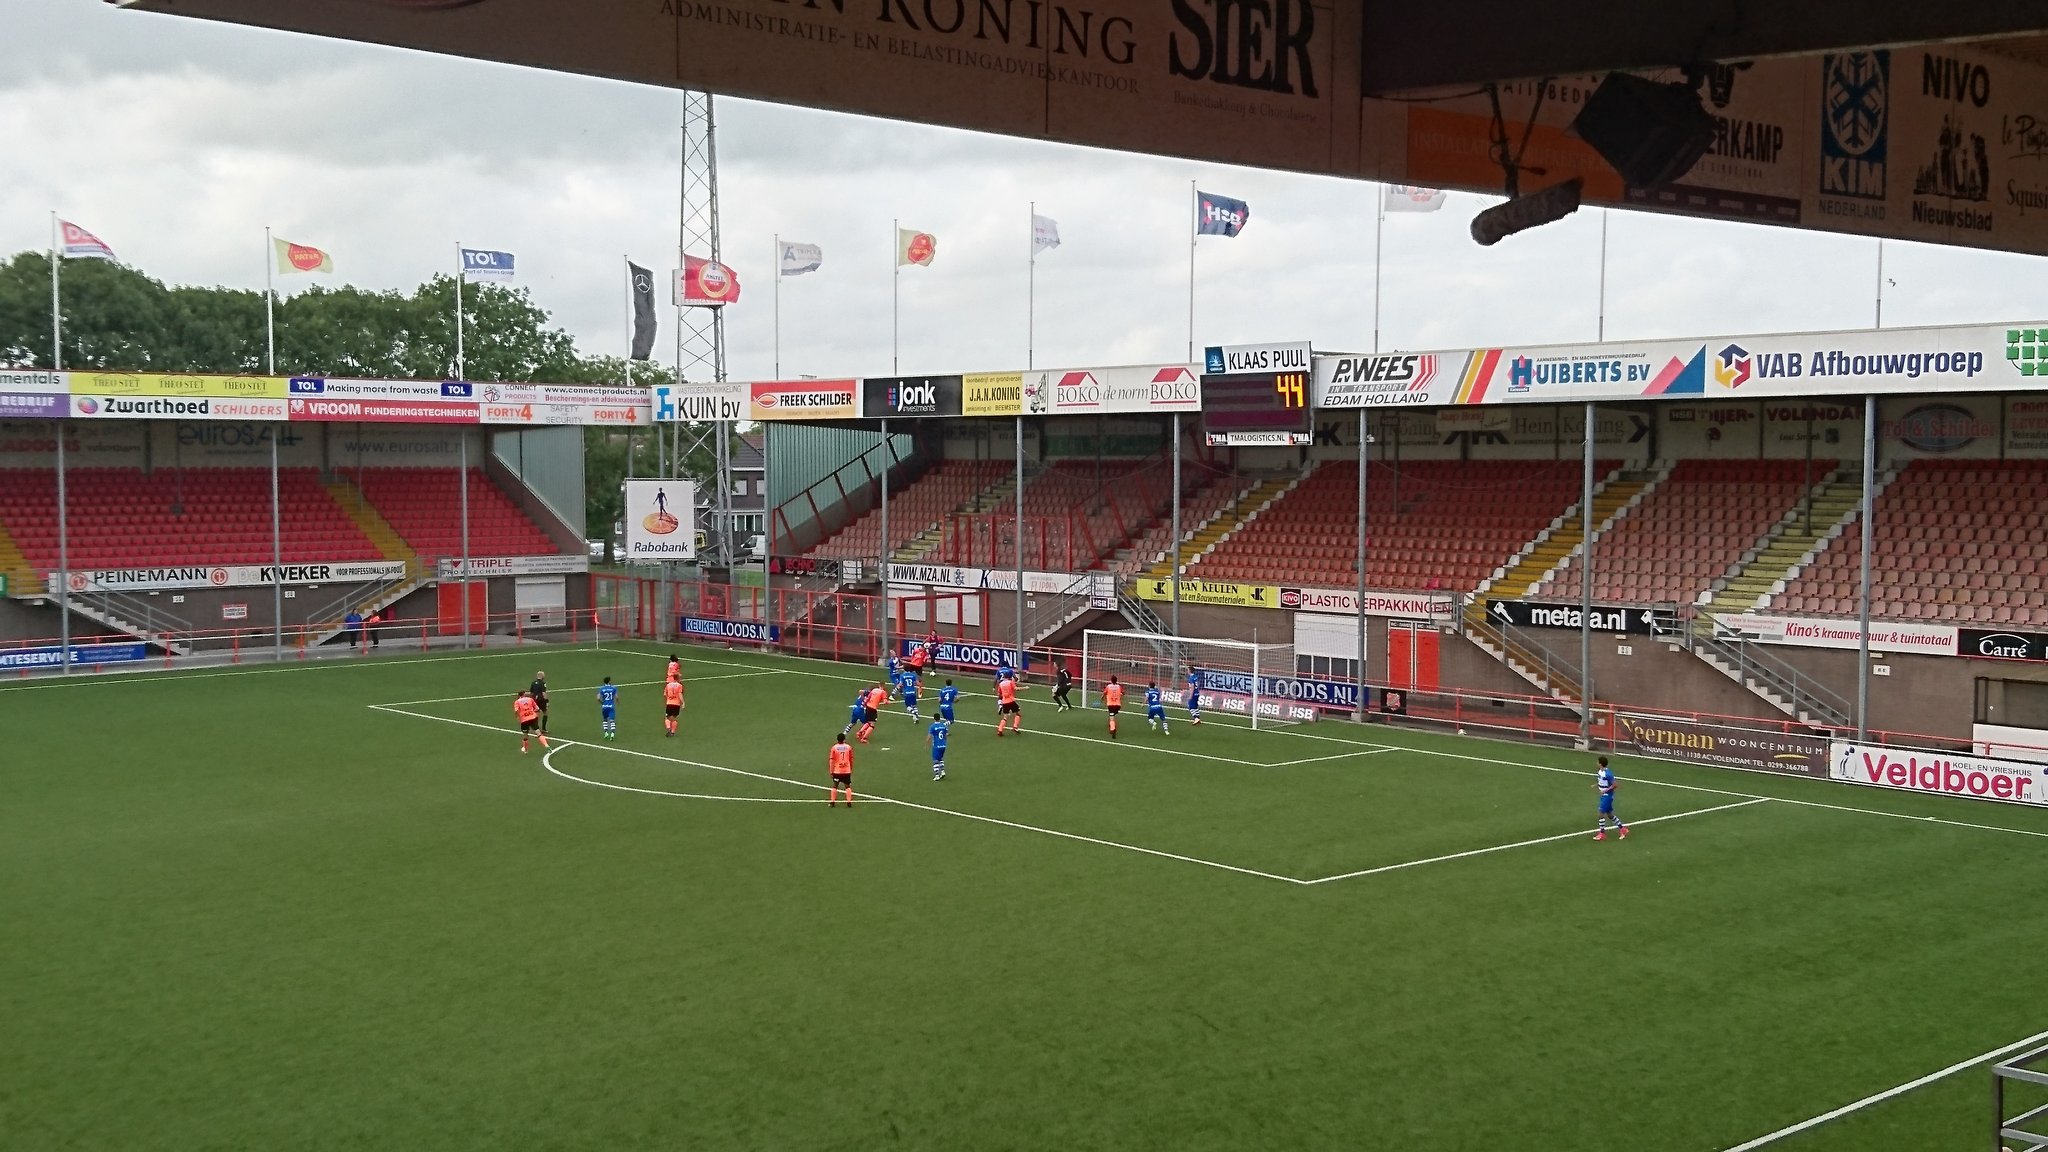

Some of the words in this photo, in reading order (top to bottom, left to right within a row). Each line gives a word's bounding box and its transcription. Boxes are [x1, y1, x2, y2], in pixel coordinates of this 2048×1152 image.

[853, 31, 881, 50] EN
[888, 36, 1140, 95] BELASTINGADVIESKANTOOR
[1922, 52, 1991, 107] NIVO
[1823, 155, 1884, 197] KIM
[1207, 204, 1242, 226] HSB
[1818, 200, 1887, 221] NEDERLAND
[1912, 200, 1993, 232] Nieuwsblad
[465, 252, 498, 266] TOL
[1228, 350, 1269, 370] KLAAS
[1272, 349, 1307, 368] PUUL
[1756, 352, 1803, 379] VAB
[1809, 350, 1983, 379] Afbouwgroep
[1511, 358, 1622, 386] HUIBERTS
[1627, 363, 1651, 382] BV
[94, 379, 117, 387] THEO
[119, 380, 140, 388] STET
[159, 380, 183, 389] THEO
[184, 380, 205, 389] STET
[223, 382, 246, 390] THEO
[247, 382, 267, 391] STET
[297, 381, 317, 390] TOL
[326, 384, 361, 394] Making
[389, 385, 411, 394] from
[412, 387, 438, 395] waste
[447, 385, 466, 394] TOL
[1352, 383, 1404, 392] TRANSPORT
[544, 387, 648, 396] www.connectproducts.nl
[898, 380, 936, 412] jonk
[1056, 385, 1100, 403] BOKO
[1102, 385, 1117, 401] de
[1117, 388, 1149, 400] norm
[1150, 382, 1198, 400] BOKO
[1277, 374, 1304, 408] 44
[780, 394, 806, 407] FREEK
[808, 393, 852, 406] SCHILDER
[1323, 394, 1361, 406] EDAM
[1363, 392, 1429, 405] HOLLAND
[104, 398, 209, 415] Zwarthoed
[213, 404, 283, 415] SCHILDERS
[309, 402, 361, 415] VROOM
[364, 407, 480, 418] FUNDERINGSTECHNIEKEN
[550, 405, 580, 413] SAFETY
[678, 396, 717, 419] KUIN
[721, 396, 741, 419] bv
[903, 404, 936, 412] investments
[994, 404, 1021, 412] BEEMSTER
[545, 416, 584, 424] SECURITY
[1514, 417, 1553, 434] Hein
[1883, 419, 1908, 438] Tol
[1912, 419, 1924, 438] &
[1210, 434, 1227, 443] TMA
[1230, 434, 1286, 442] TMALOGISTICS.NL
[1292, 433, 1310, 442] TMA
[633, 541, 689, 553] Rabobank
[469, 558, 513, 569] TRIPLE
[94, 567, 208, 584] PEINEMANN
[260, 565, 331, 582] KWEKER
[335, 568, 349, 577] VOOR
[893, 565, 951, 583] WWW.MZA.NL
[1181, 581, 1198, 592] VAN
[1202, 582, 1239, 595] KEULEN
[1092, 599, 1107, 607] HSB
[1301, 593, 1350, 609] PLASTIC
[1531, 606, 1627, 631] metaa.nl
[1785, 622, 1820, 638] Kino's
[1890, 631, 1899, 643] &
[1900, 633, 1952, 647] tuintotaal
[1979, 639, 2027, 658] Carré
[905, 678, 913, 687] 13
[603, 692, 613, 701] 21
[944, 692, 950, 701] 4
[1151, 693, 1158, 702] 2
[1161, 690, 1182, 703] HSB
[1197, 695, 1213, 706] SB
[1222, 698, 1246, 711] HSB
[1257, 702, 1280, 716] HSB
[1289, 706, 1314, 720] HSB
[938, 730, 944, 740] 6
[1717, 737, 1824, 756] WOONCENTRUM
[1701, 753, 1712, 761] AC
[1862, 752, 2033, 799] Veldboer
[1952, 761, 1975, 771] KOEL-
[1976, 764, 1988, 773] EN
[1989, 766, 2033, 777] VRIESHUIS
